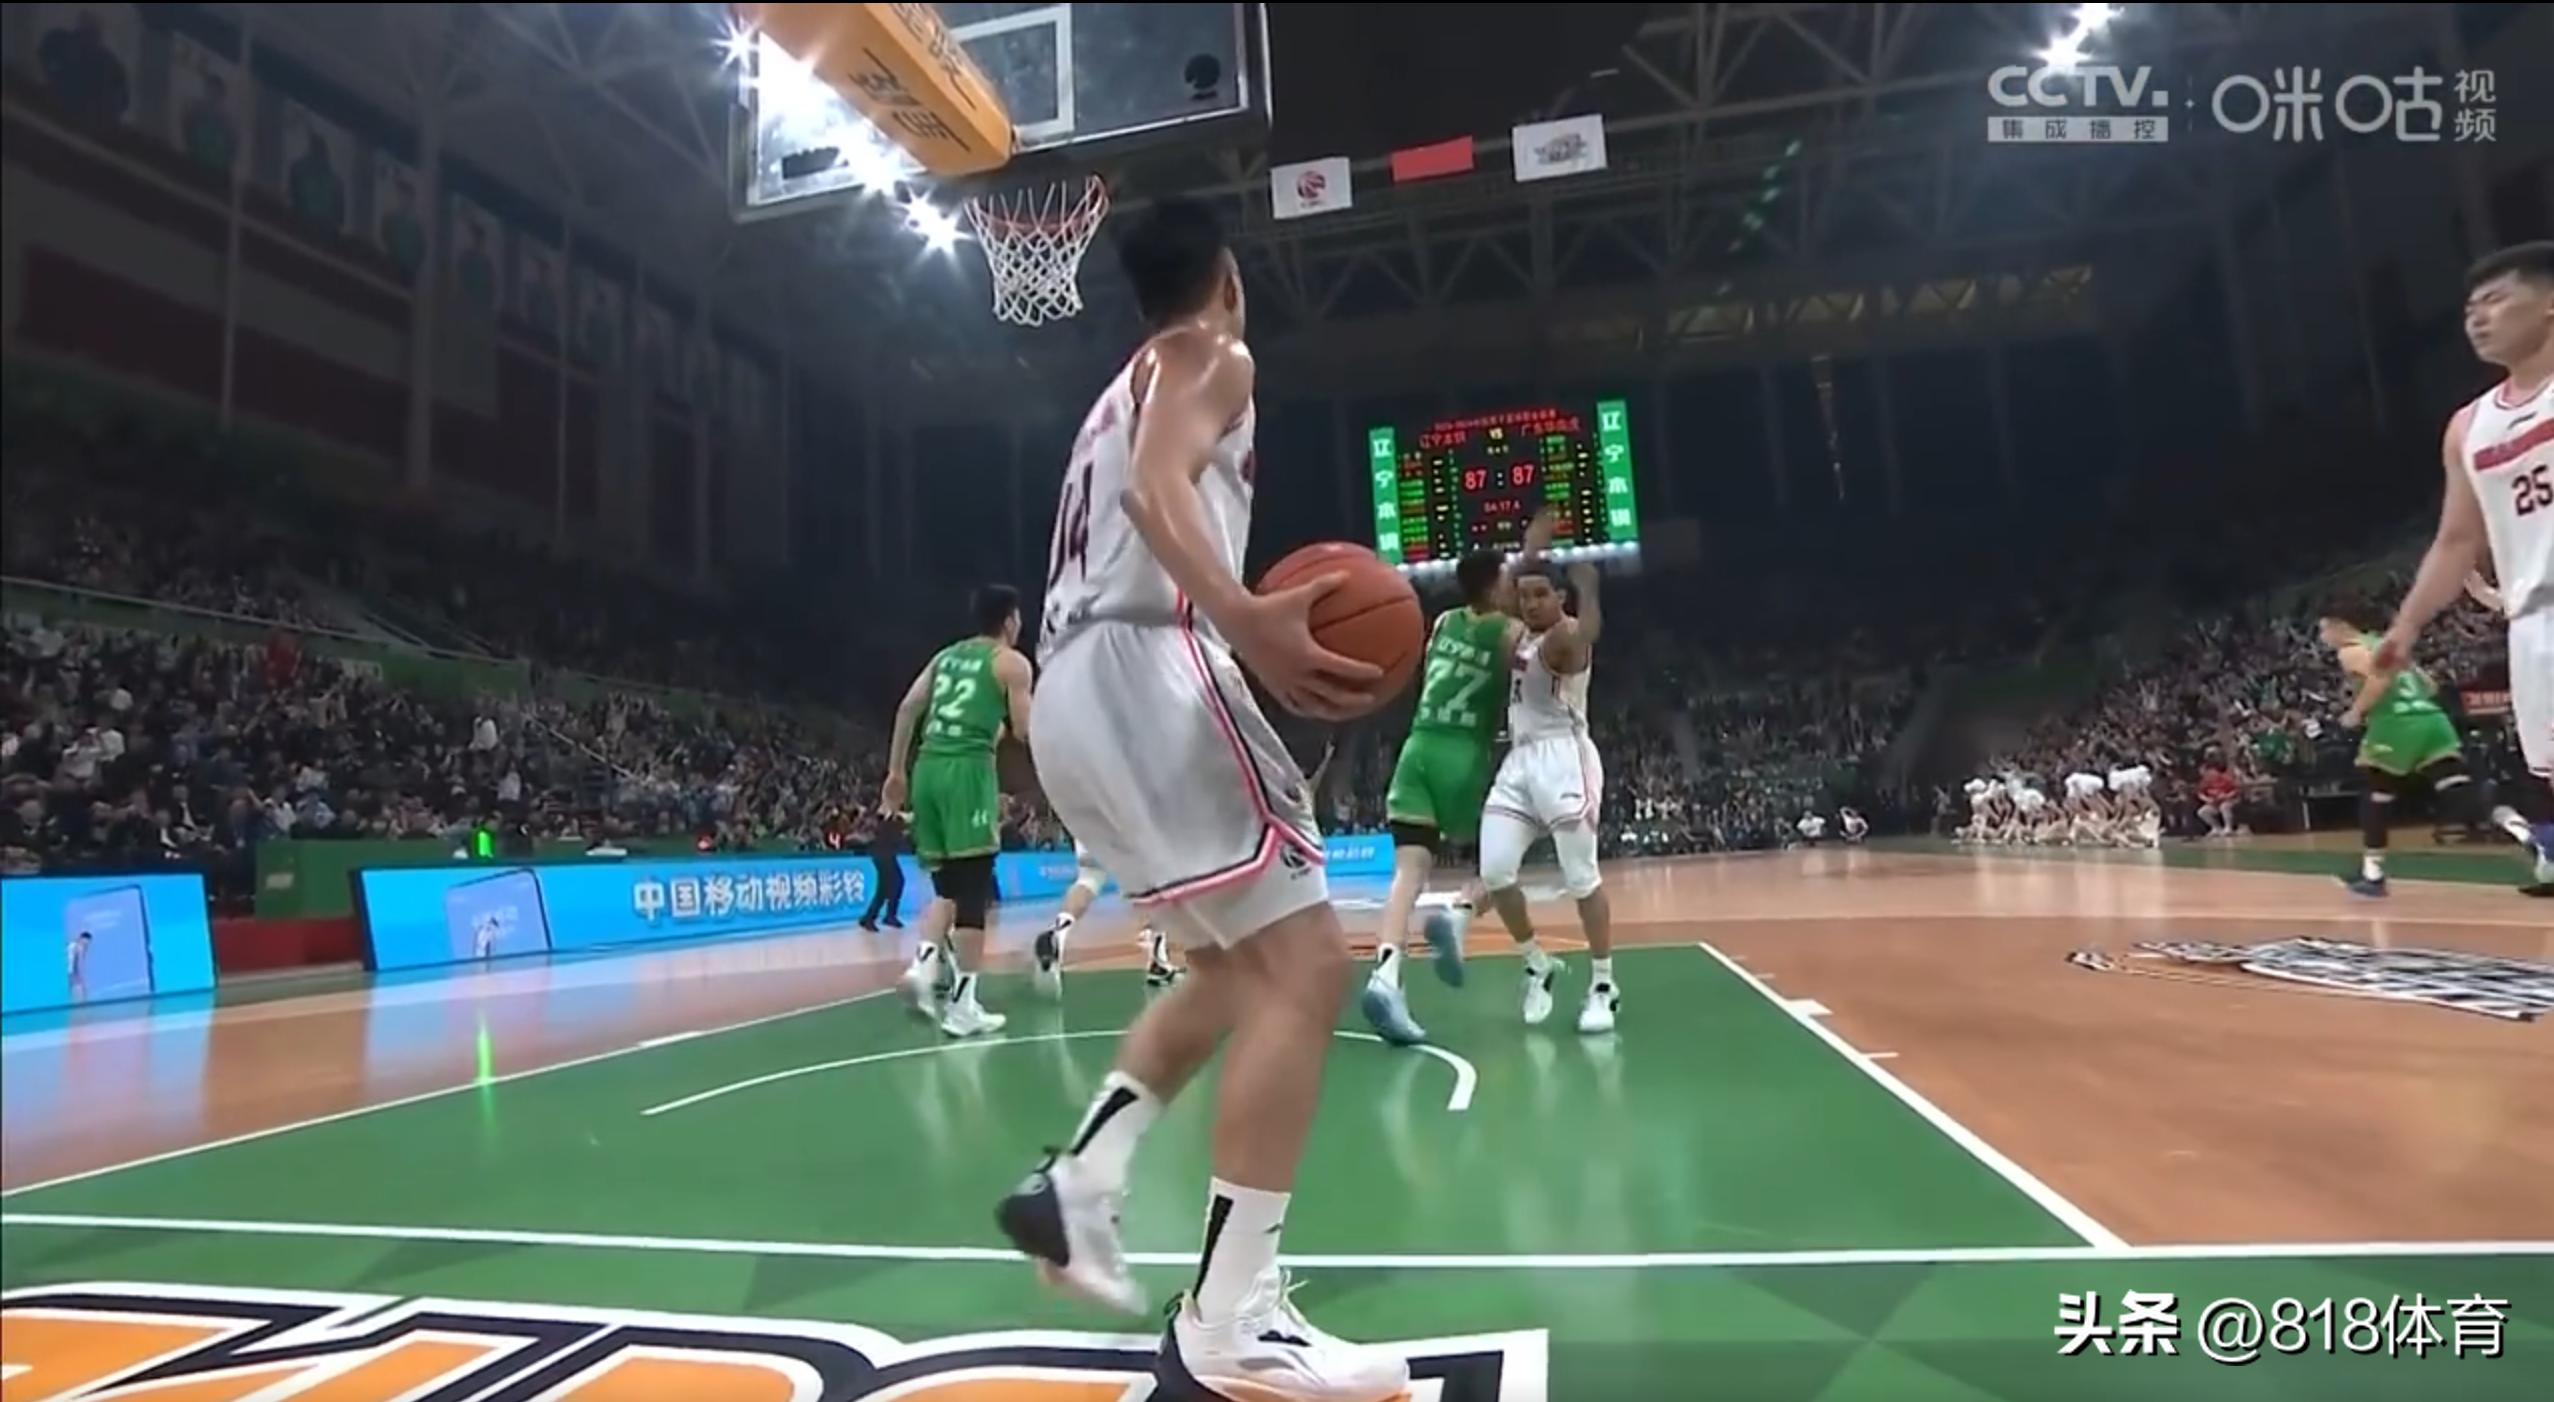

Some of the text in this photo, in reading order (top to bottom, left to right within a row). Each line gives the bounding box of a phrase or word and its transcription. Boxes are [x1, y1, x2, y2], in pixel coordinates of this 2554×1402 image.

[1465, 463, 1534, 490] 87 87
[2512, 464, 2553, 516] 25
[632, 869, 866, 922] 中国移动视频彩铃
